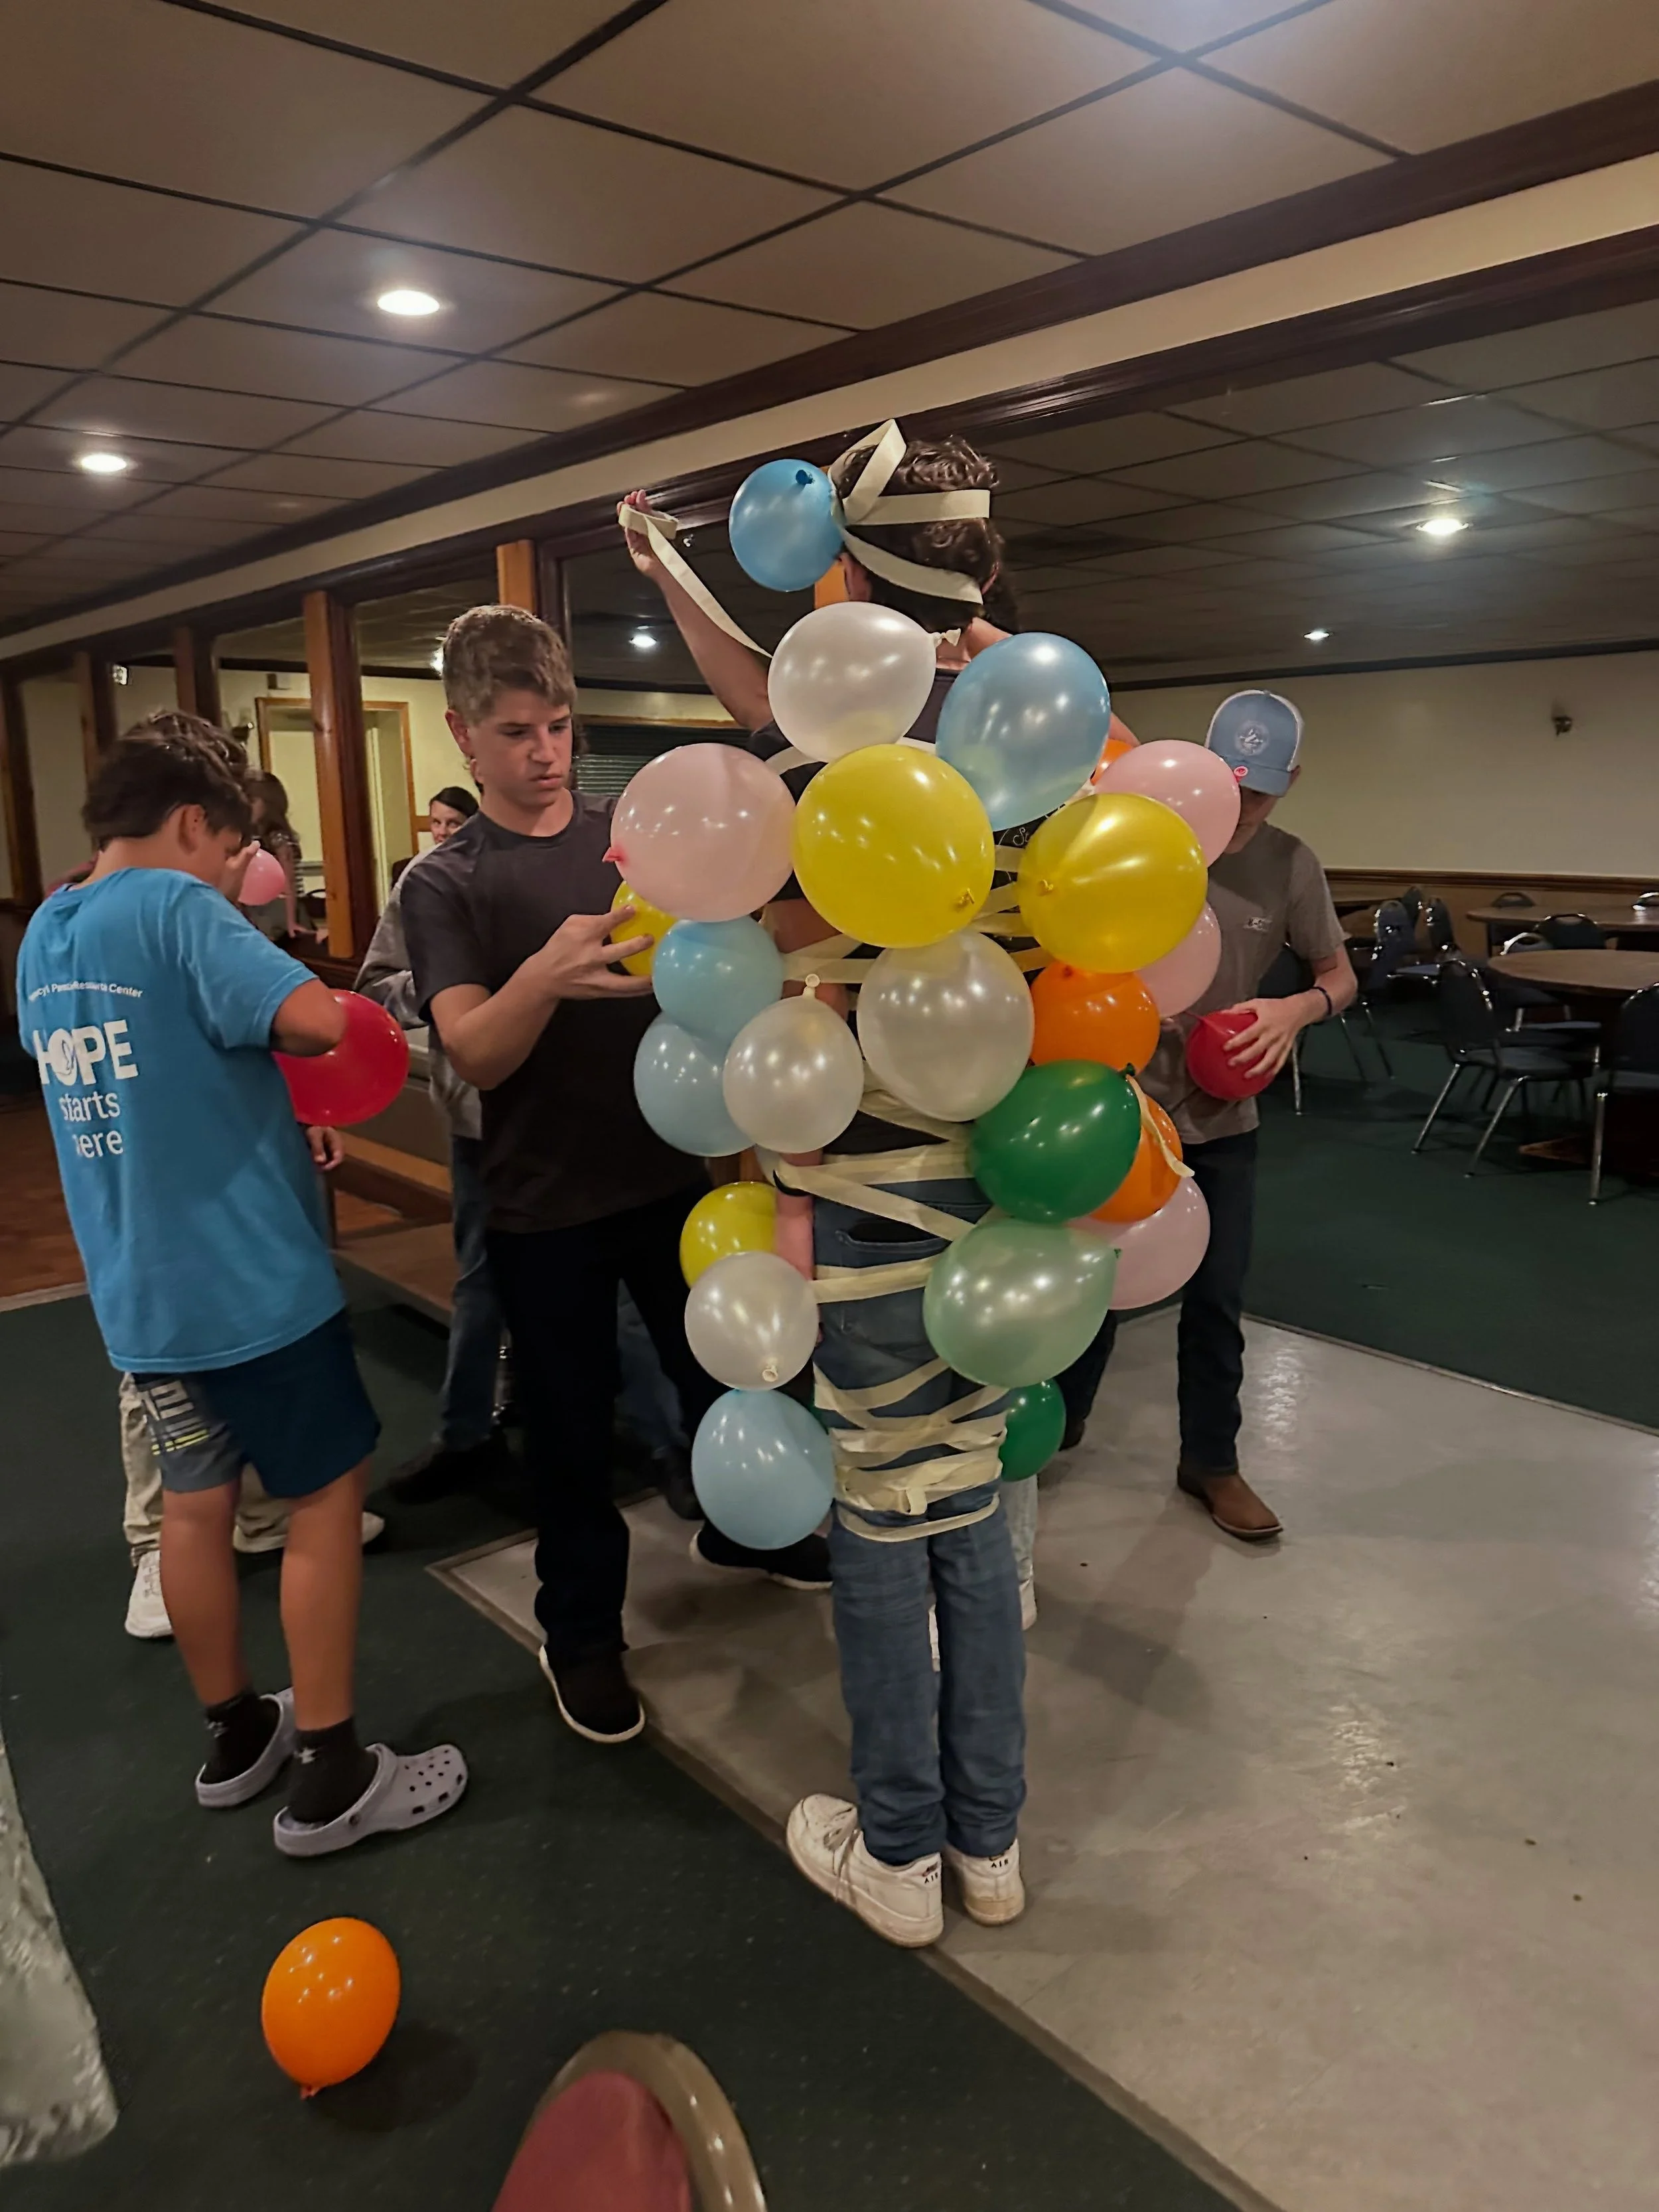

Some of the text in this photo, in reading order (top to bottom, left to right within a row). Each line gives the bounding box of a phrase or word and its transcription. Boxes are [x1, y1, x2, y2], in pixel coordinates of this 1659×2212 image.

[109, 983, 143, 998] Center
[33, 1019, 139, 1086] HOPE
[58, 1091, 121, 1122] starts
[991, 1859, 1009, 1868] AIR
